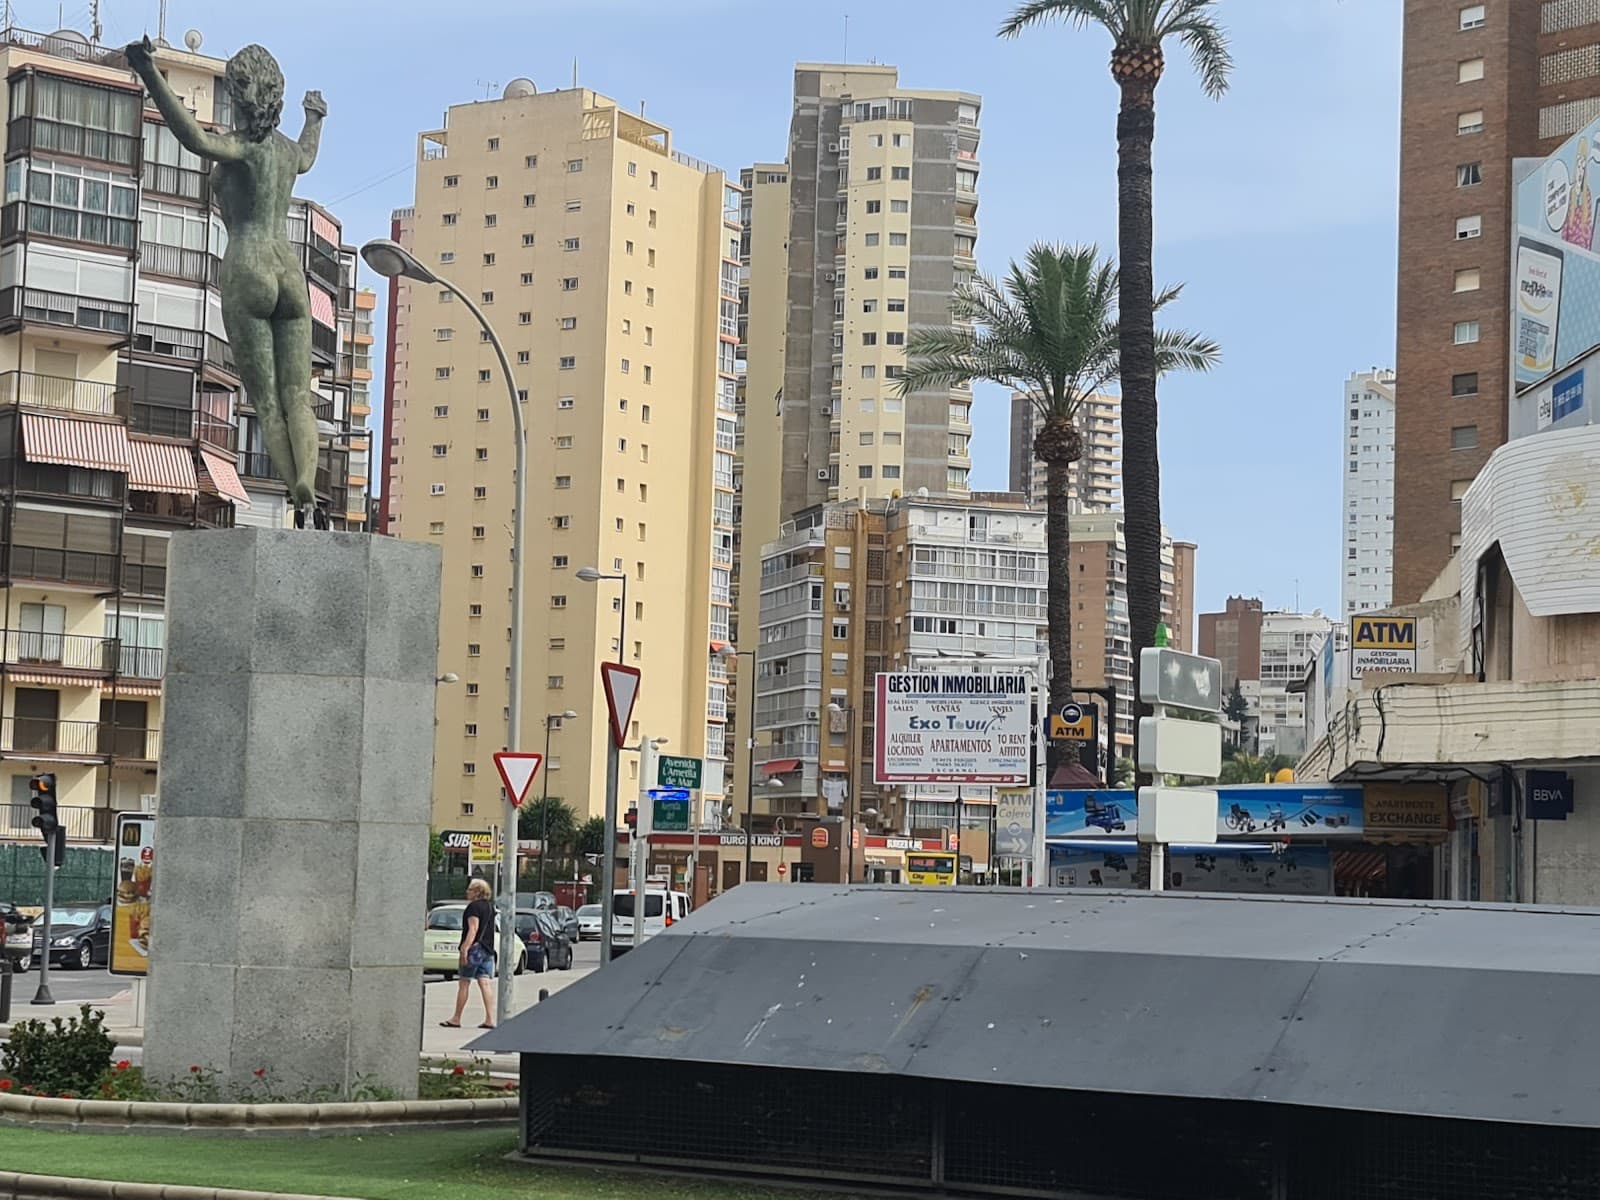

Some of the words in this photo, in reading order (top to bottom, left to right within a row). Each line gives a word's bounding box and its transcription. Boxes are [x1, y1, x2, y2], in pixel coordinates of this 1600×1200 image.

[1356, 622, 1413, 643] ATM
[1358, 657, 1410, 665] INMOBILIARIA
[888, 675, 939, 693] GESTION
[942, 676, 1026, 694] INMOBILIARIA
[931, 705, 961, 713] VENTAS
[1056, 728, 1084, 736] ATM
[891, 733, 921, 744] ALQUILER
[997, 734, 1007, 744] TO
[1009, 734, 1026, 744] RENT
[887, 745, 924, 756] LOCATIONS
[930, 739, 992, 753] APARTAMENTOS
[665, 758, 696, 769] Avenida
[665, 777, 676, 785] de
[678, 778, 693, 787] Mar
[1000, 794, 1031, 806] ATM
[1533, 789, 1563, 801] BBVA
[999, 808, 1031, 820] Cajero
[1369, 812, 1441, 825] EXCHANGE
[757, 836, 781, 846] KING
